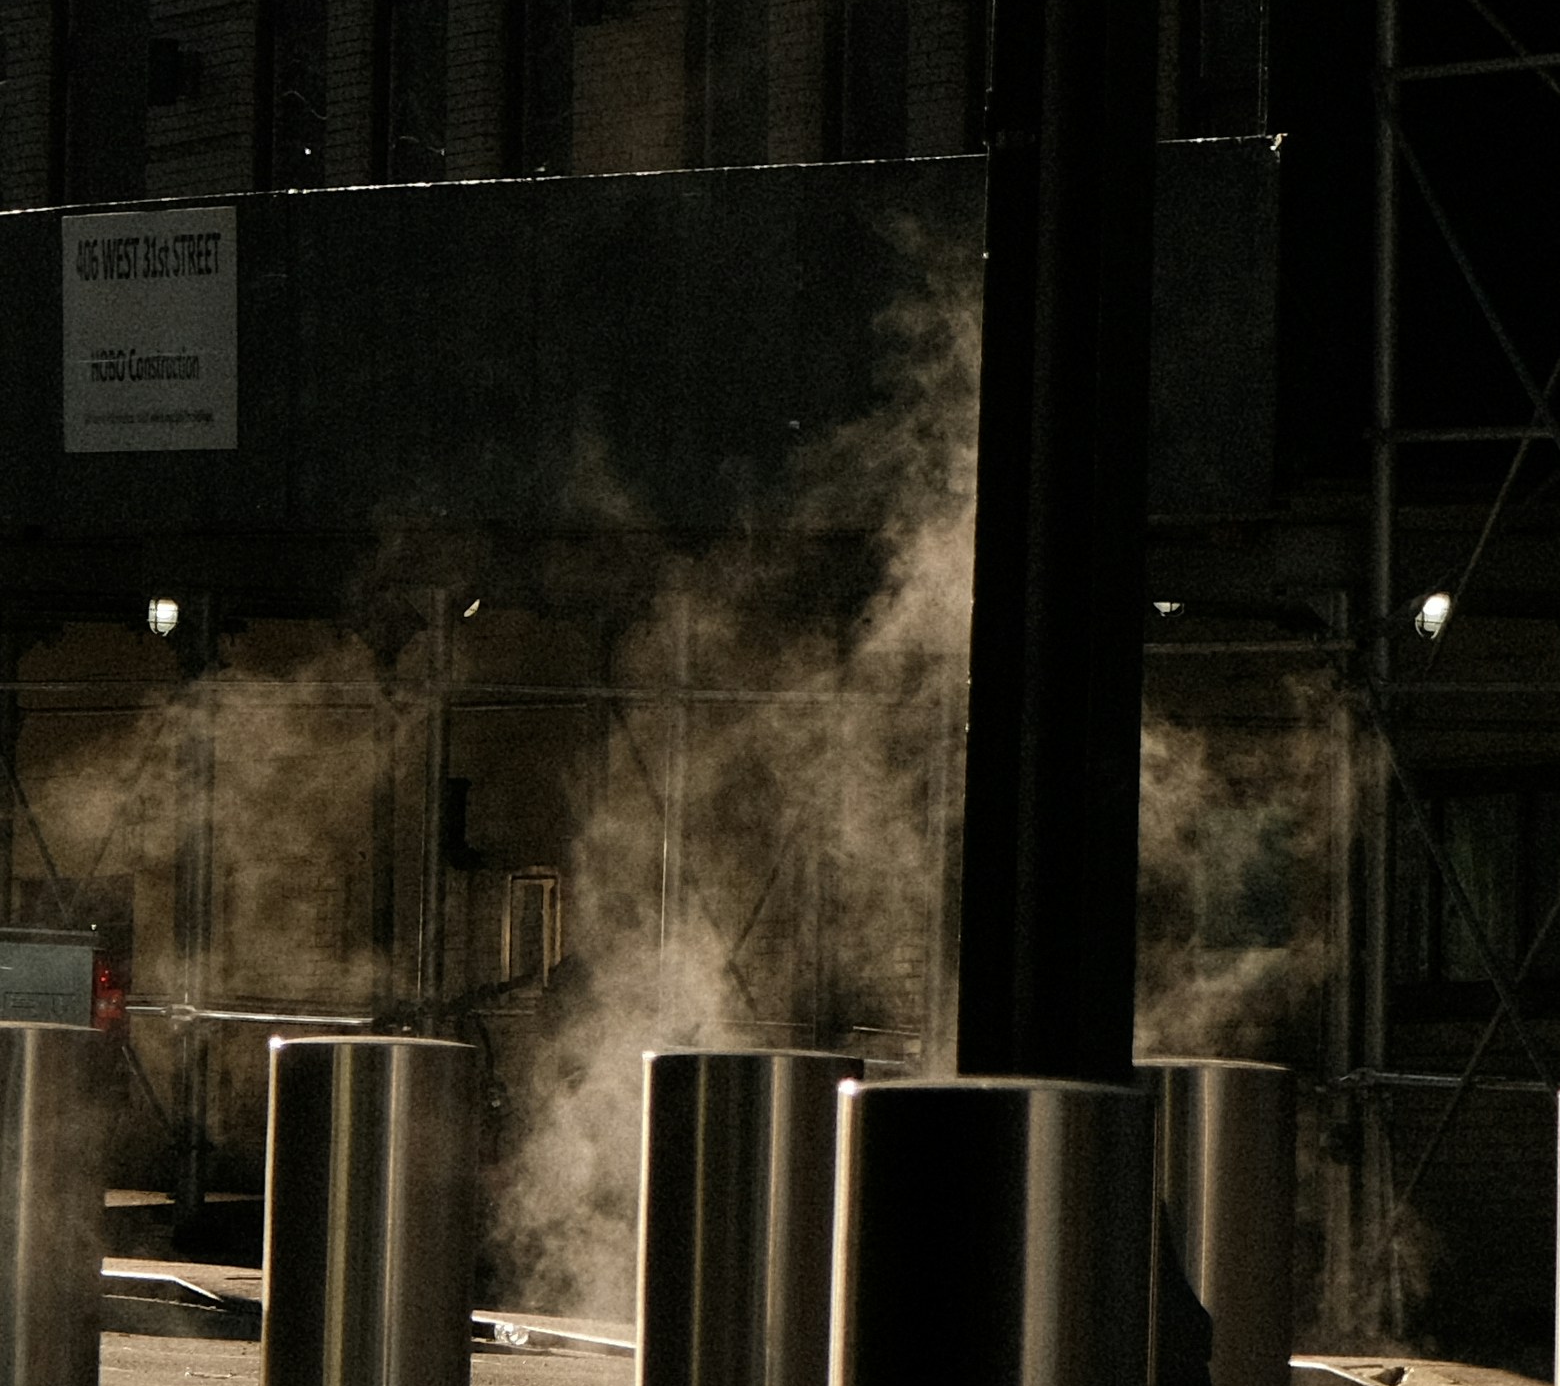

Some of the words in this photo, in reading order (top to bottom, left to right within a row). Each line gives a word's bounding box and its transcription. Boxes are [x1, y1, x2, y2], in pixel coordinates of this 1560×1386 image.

[102, 236, 140, 280] WEST
[143, 234, 171, 279] 31st
[173, 232, 221, 277] STREET
[128, 346, 200, 382] Construction
